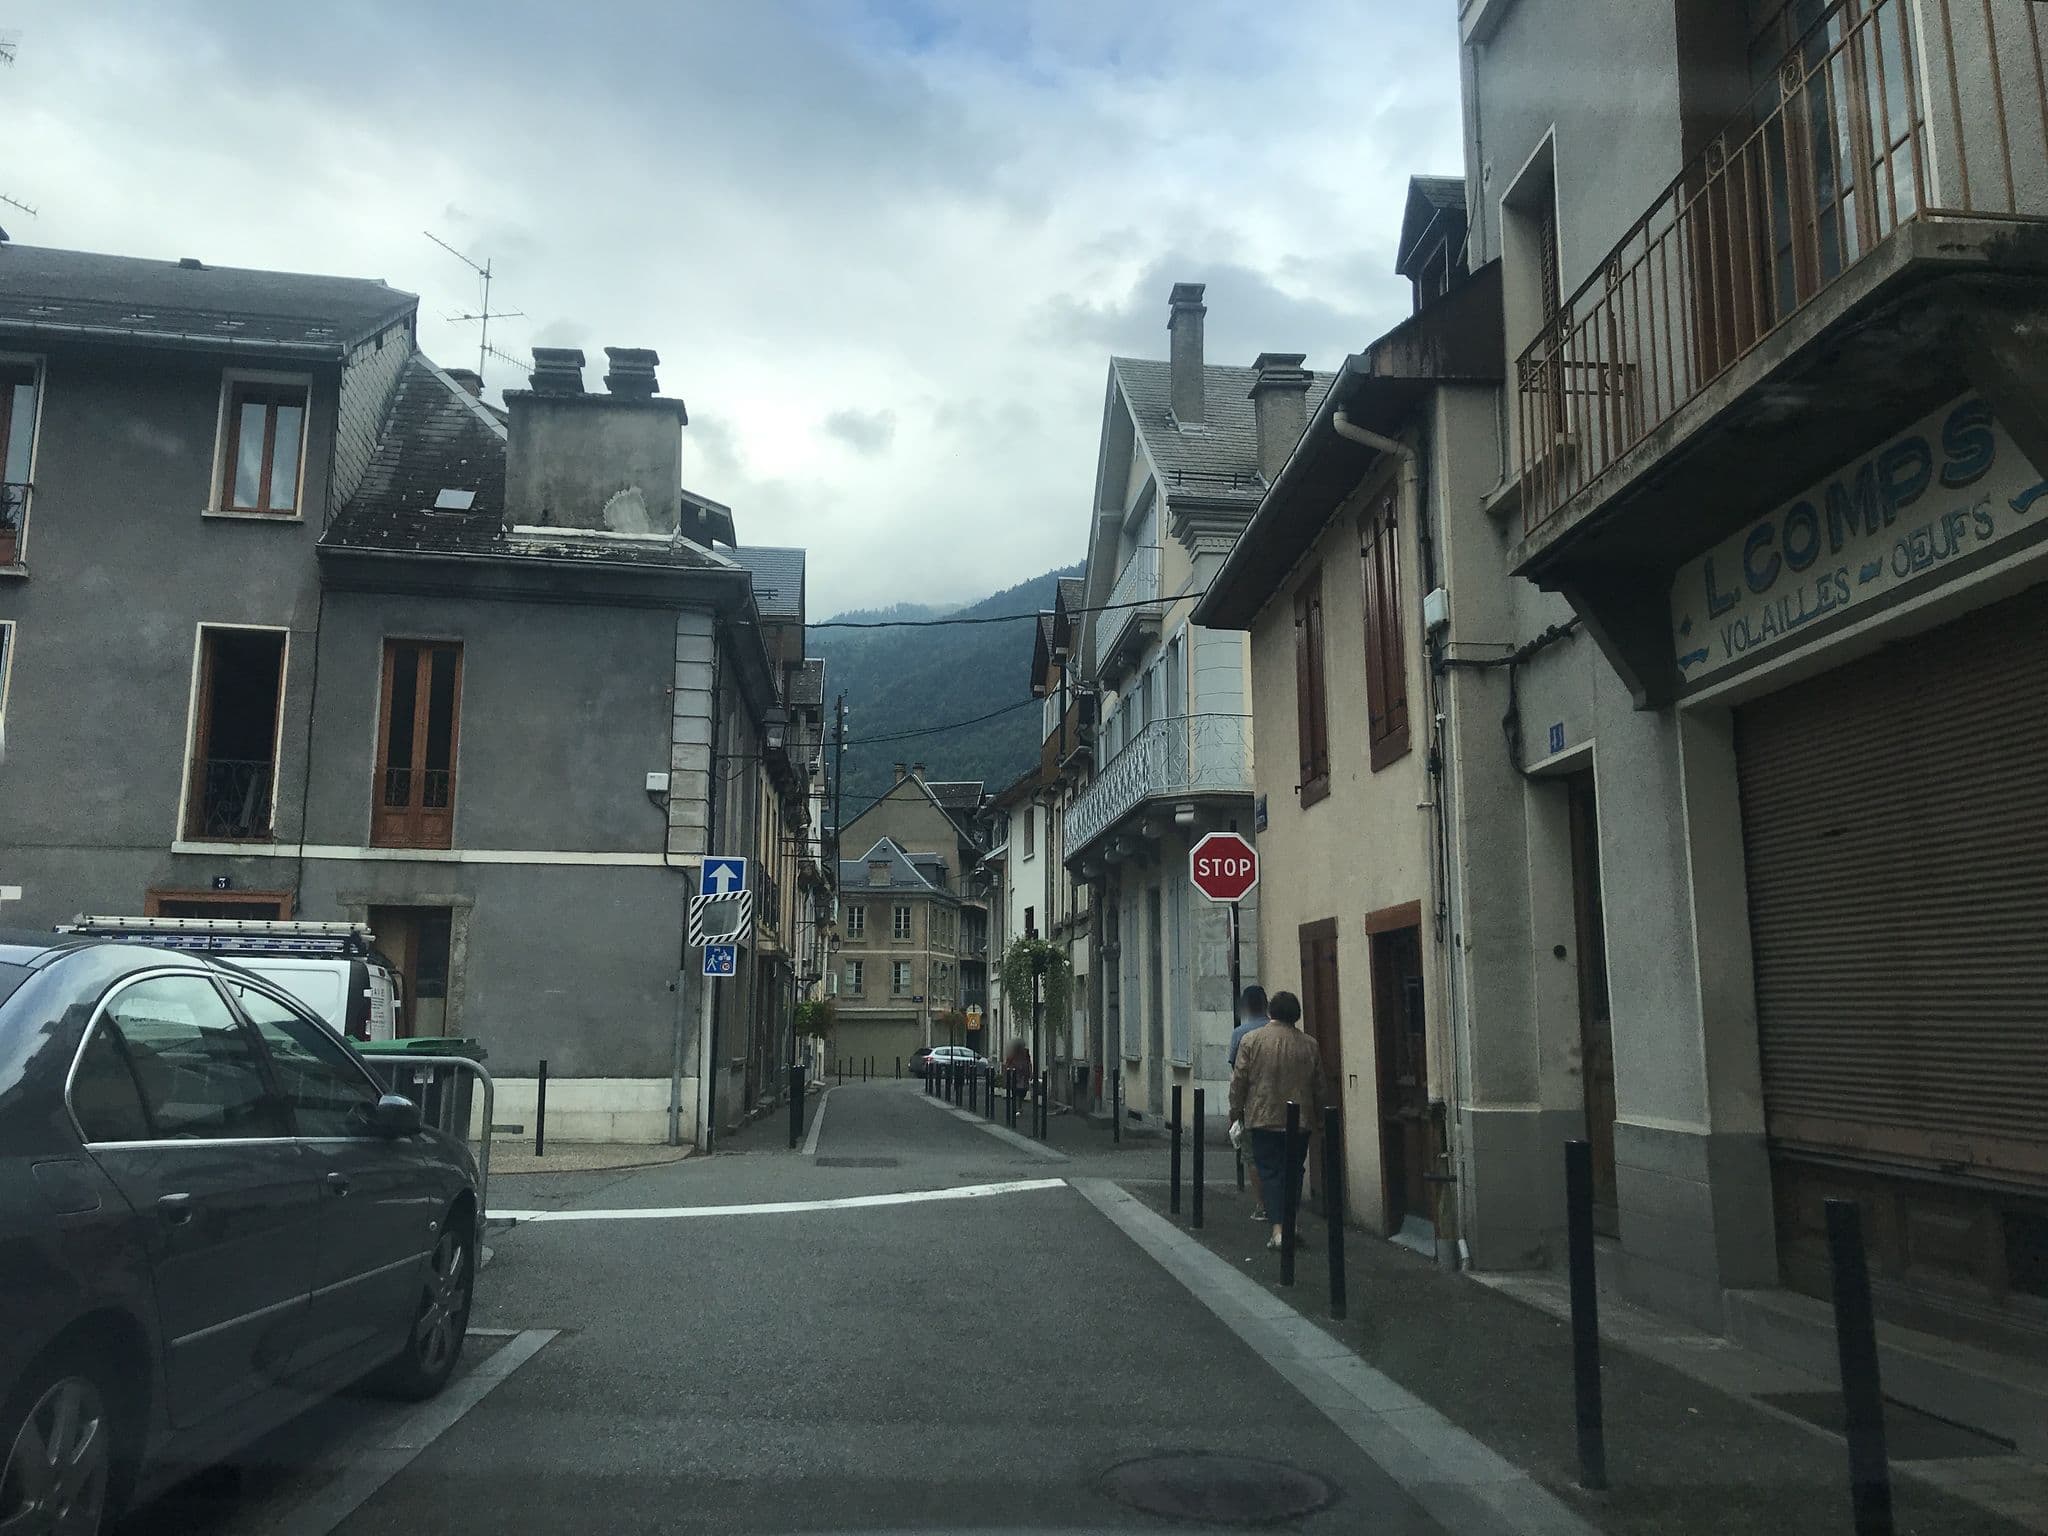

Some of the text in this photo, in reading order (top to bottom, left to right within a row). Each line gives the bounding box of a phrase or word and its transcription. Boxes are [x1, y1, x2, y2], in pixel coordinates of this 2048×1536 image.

[1720, 566, 1852, 658] VOLAILLES
[1198, 858, 1251, 877] STOP
[218, 877, 226, 889] 3
